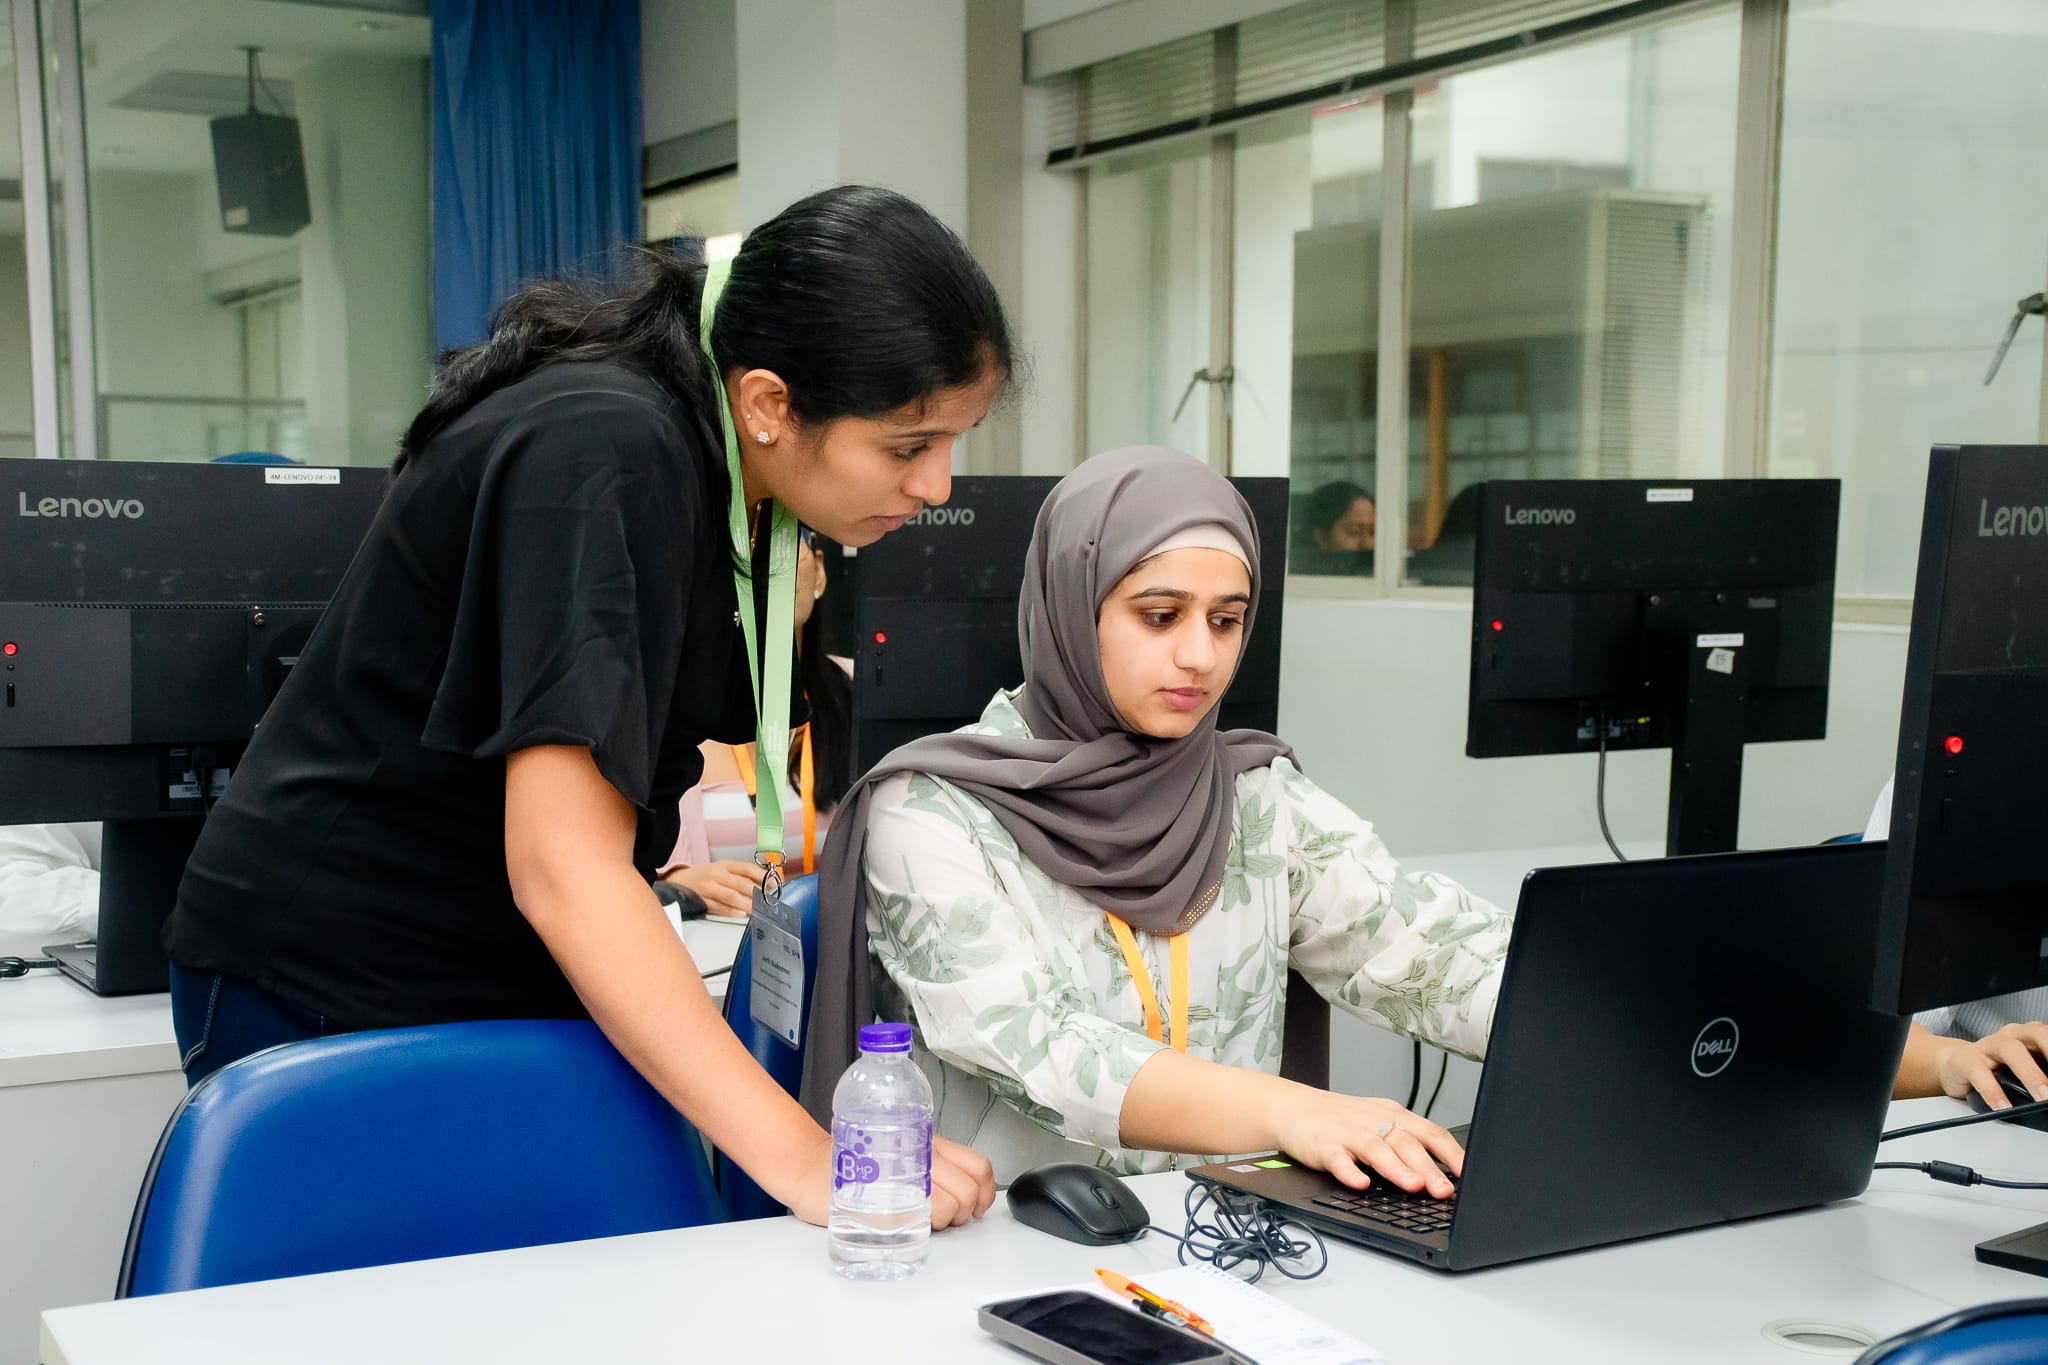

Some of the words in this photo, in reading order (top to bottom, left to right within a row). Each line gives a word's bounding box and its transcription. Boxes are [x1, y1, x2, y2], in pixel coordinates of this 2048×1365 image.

[19, 491, 145, 519] Lenovo
[1505, 505, 1576, 525] Lenovo
[1978, 498, 2048, 537] Leno
[1697, 1038, 1732, 1056] DELL
